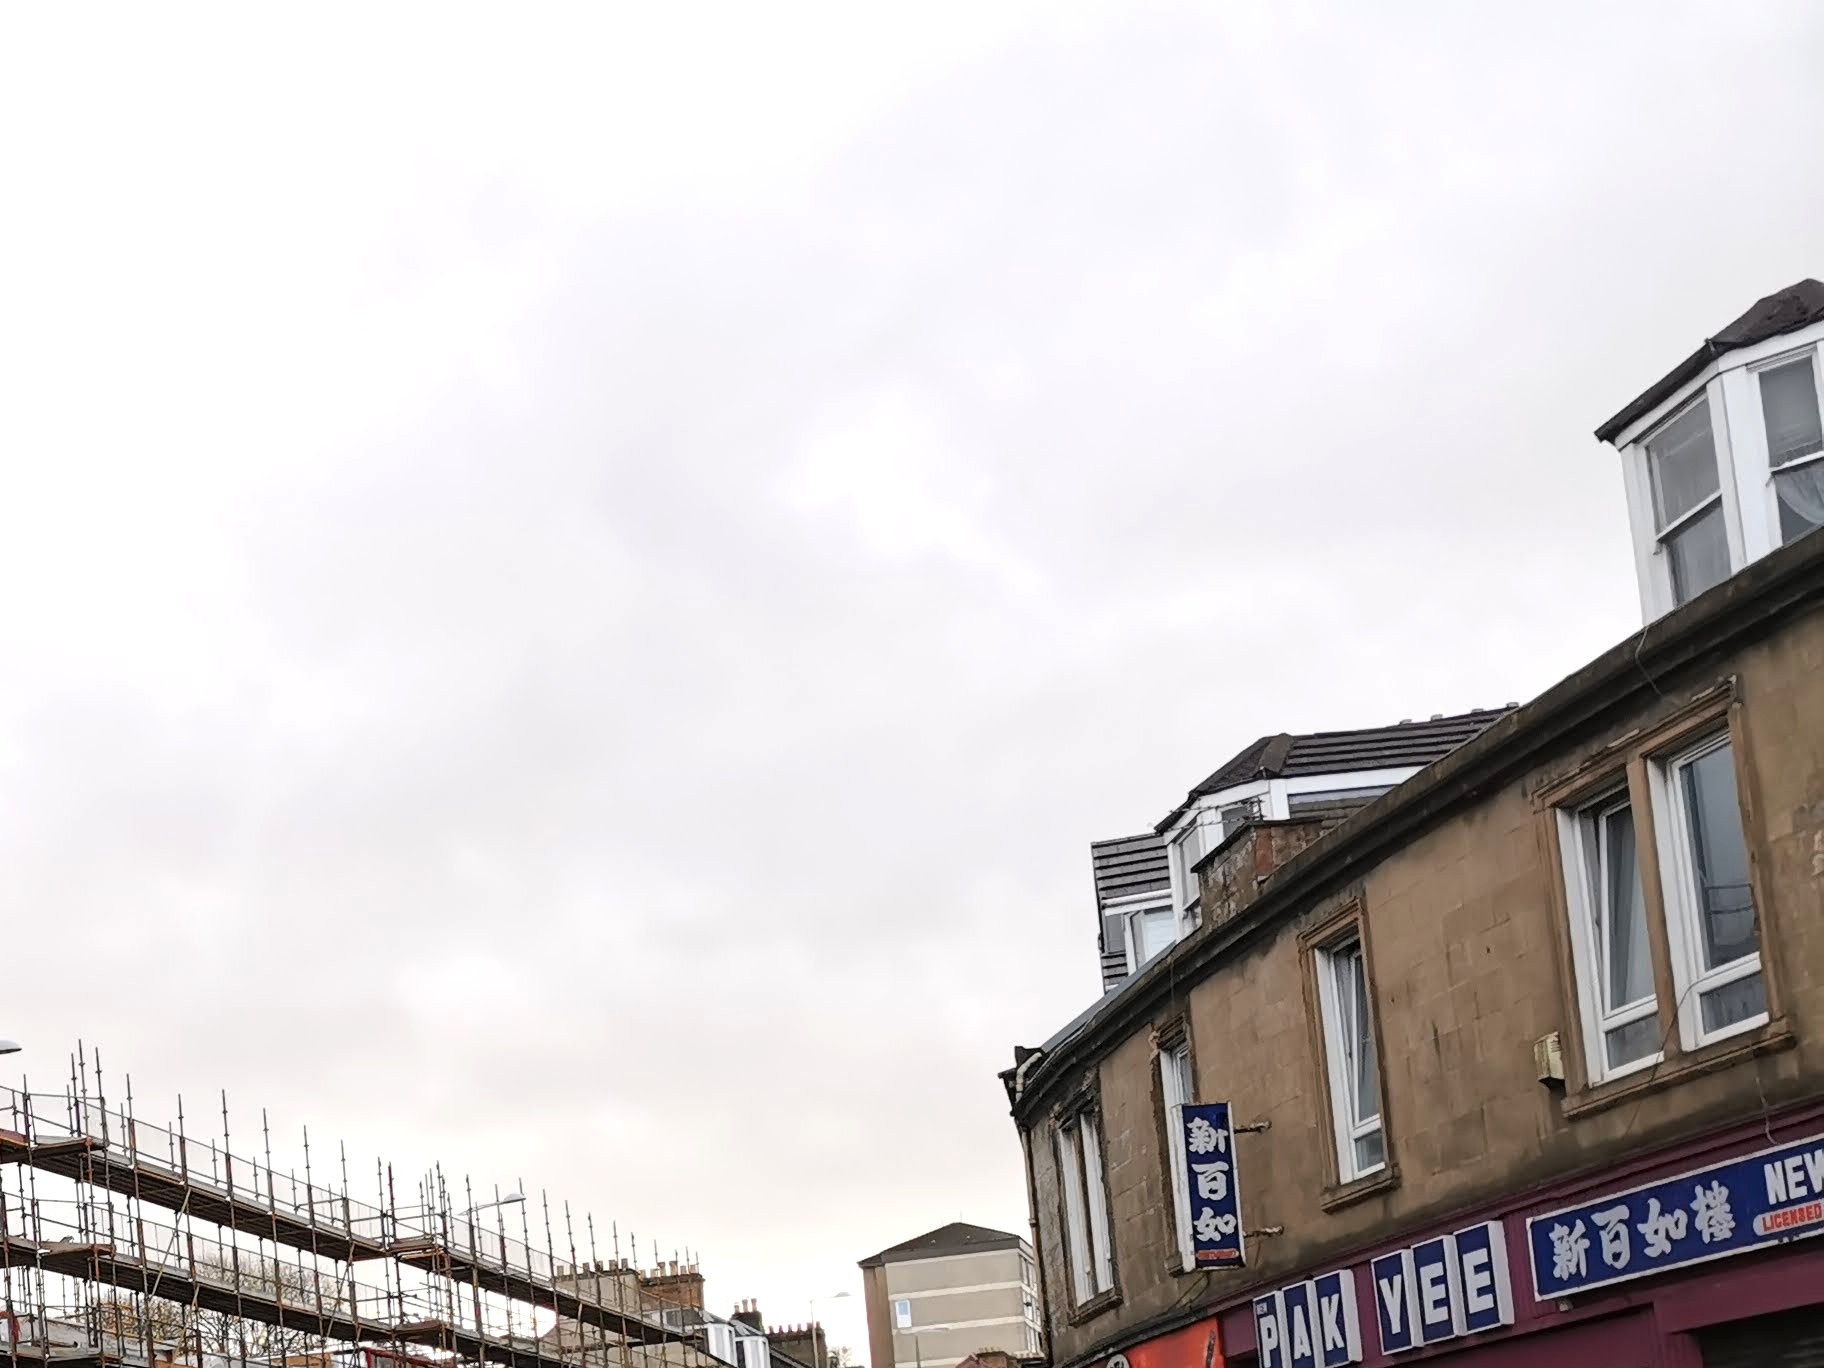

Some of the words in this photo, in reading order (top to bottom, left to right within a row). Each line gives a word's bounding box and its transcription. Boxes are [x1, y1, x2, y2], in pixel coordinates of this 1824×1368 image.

[1187, 1116, 1237, 1242] 新百如
[1762, 1203, 1822, 1232] LICENSED
[1259, 1293, 1344, 1368] PAK
[1379, 1248, 1495, 1335] YEE
